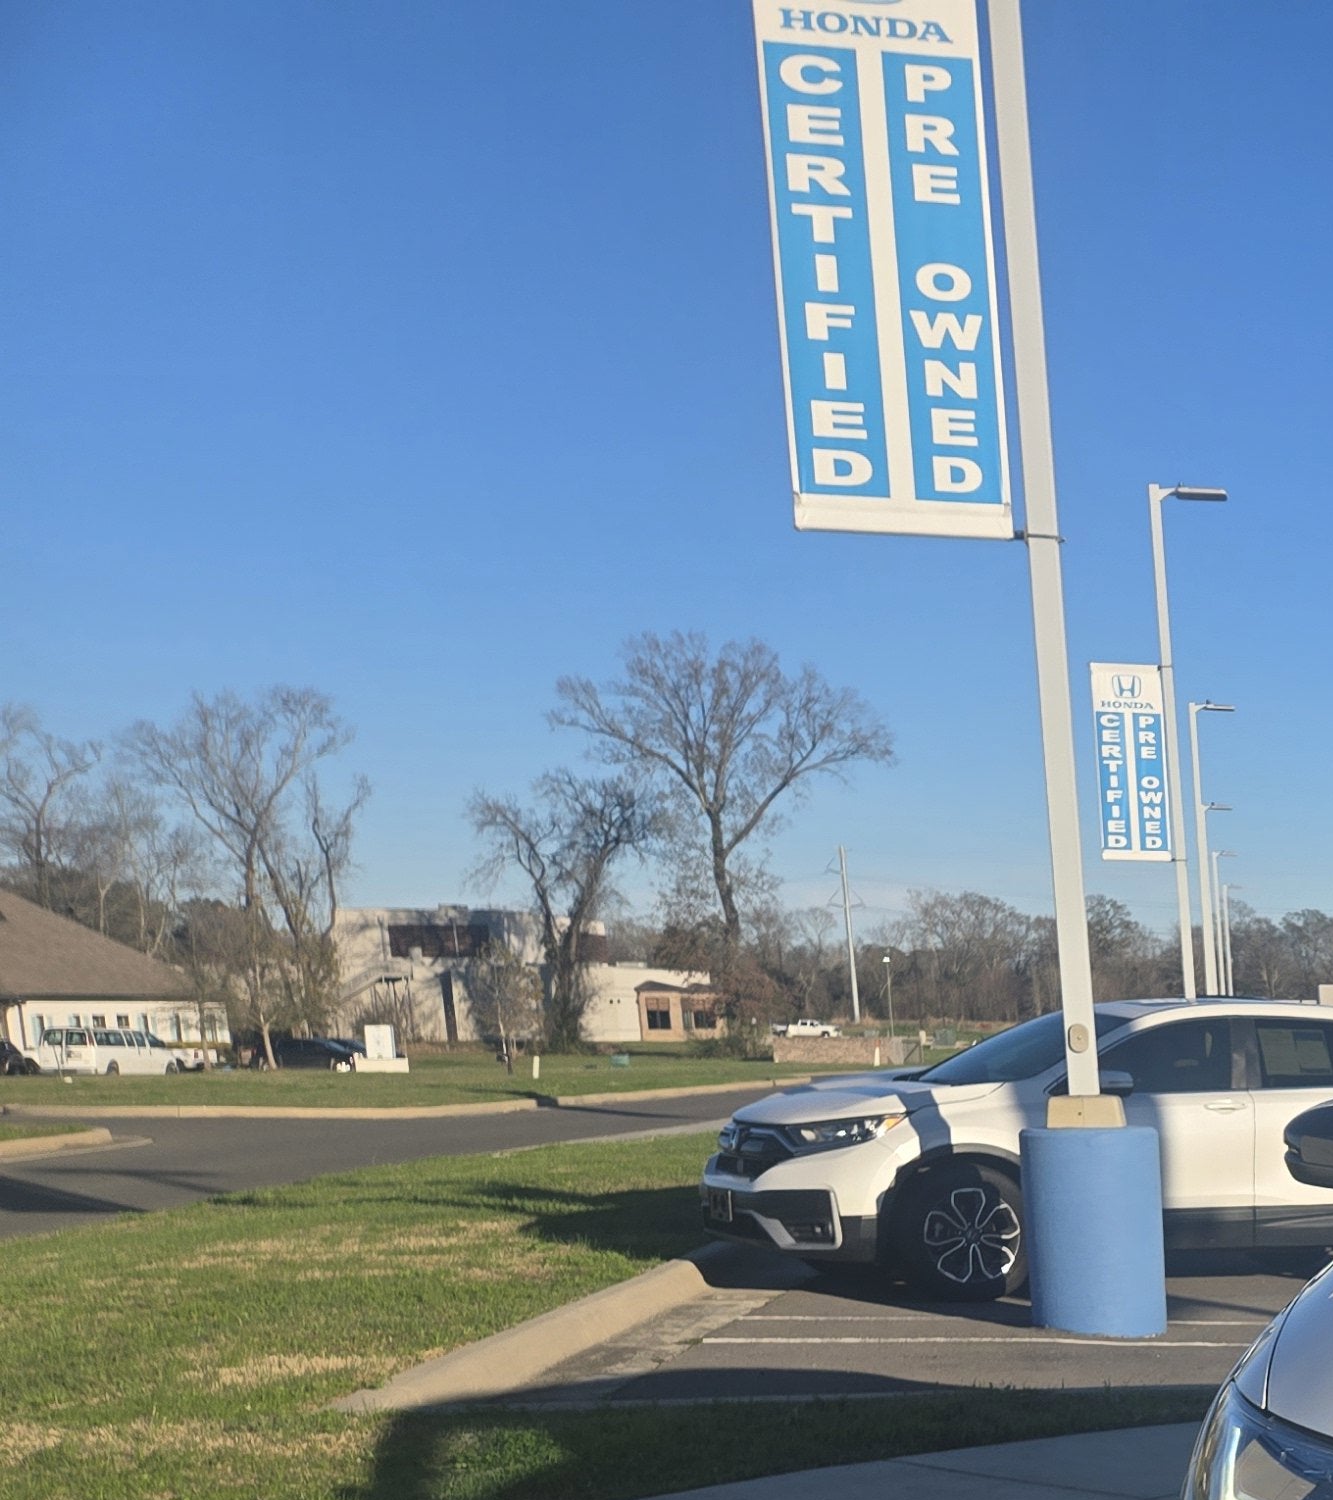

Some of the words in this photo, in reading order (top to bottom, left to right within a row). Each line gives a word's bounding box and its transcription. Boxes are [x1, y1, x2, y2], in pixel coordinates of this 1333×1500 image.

[780, 9, 954, 43] HONDA
[904, 63, 960, 206] PRE
[778, 54, 874, 486] CERTIFIED
[909, 262, 984, 494] OWNED
[1100, 700, 1154, 710] HONDA
[1138, 715, 1157, 760] PRE
[1099, 714, 1128, 848] CERTIFIED
[1139, 776, 1163, 849] OWNED
